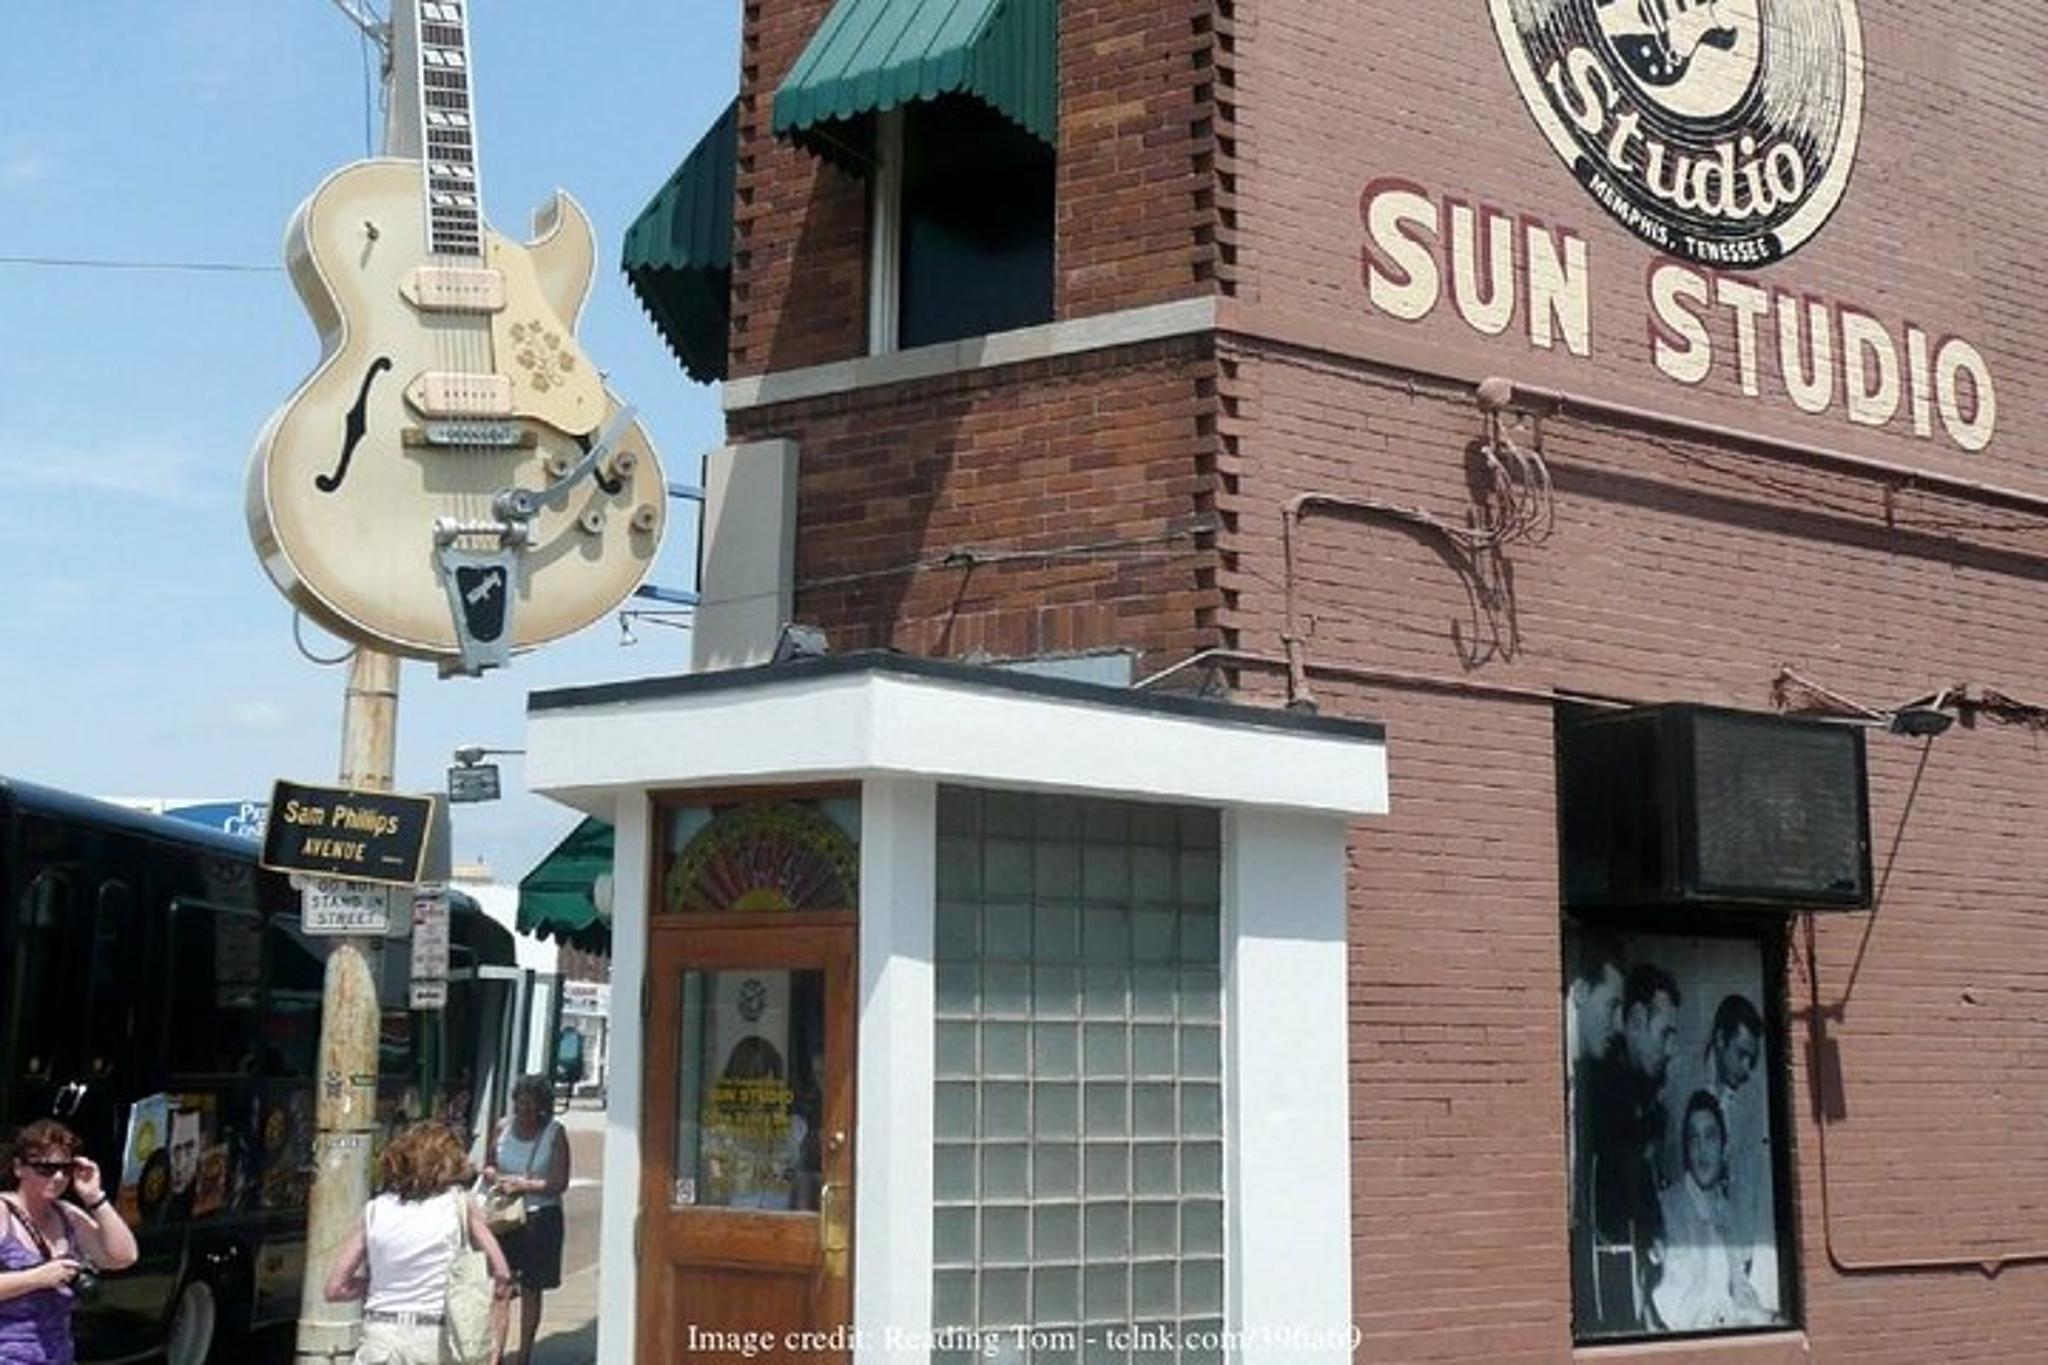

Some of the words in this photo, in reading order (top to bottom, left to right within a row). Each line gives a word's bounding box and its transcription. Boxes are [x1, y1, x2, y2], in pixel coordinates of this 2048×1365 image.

[1547, 47, 1805, 219] Studio
[1588, 173, 1677, 249] MEMPHIS,
[1686, 235, 1770, 263] TENESSEE
[1362, 180, 1591, 357] SUN
[1648, 259, 1997, 453] STUDIO
[284, 800, 325, 827] Sam
[332, 804, 399, 838] Phillips
[301, 837, 367, 863] AVENUE
[311, 894, 362, 908] STAND
[317, 911, 376, 925] STREET
